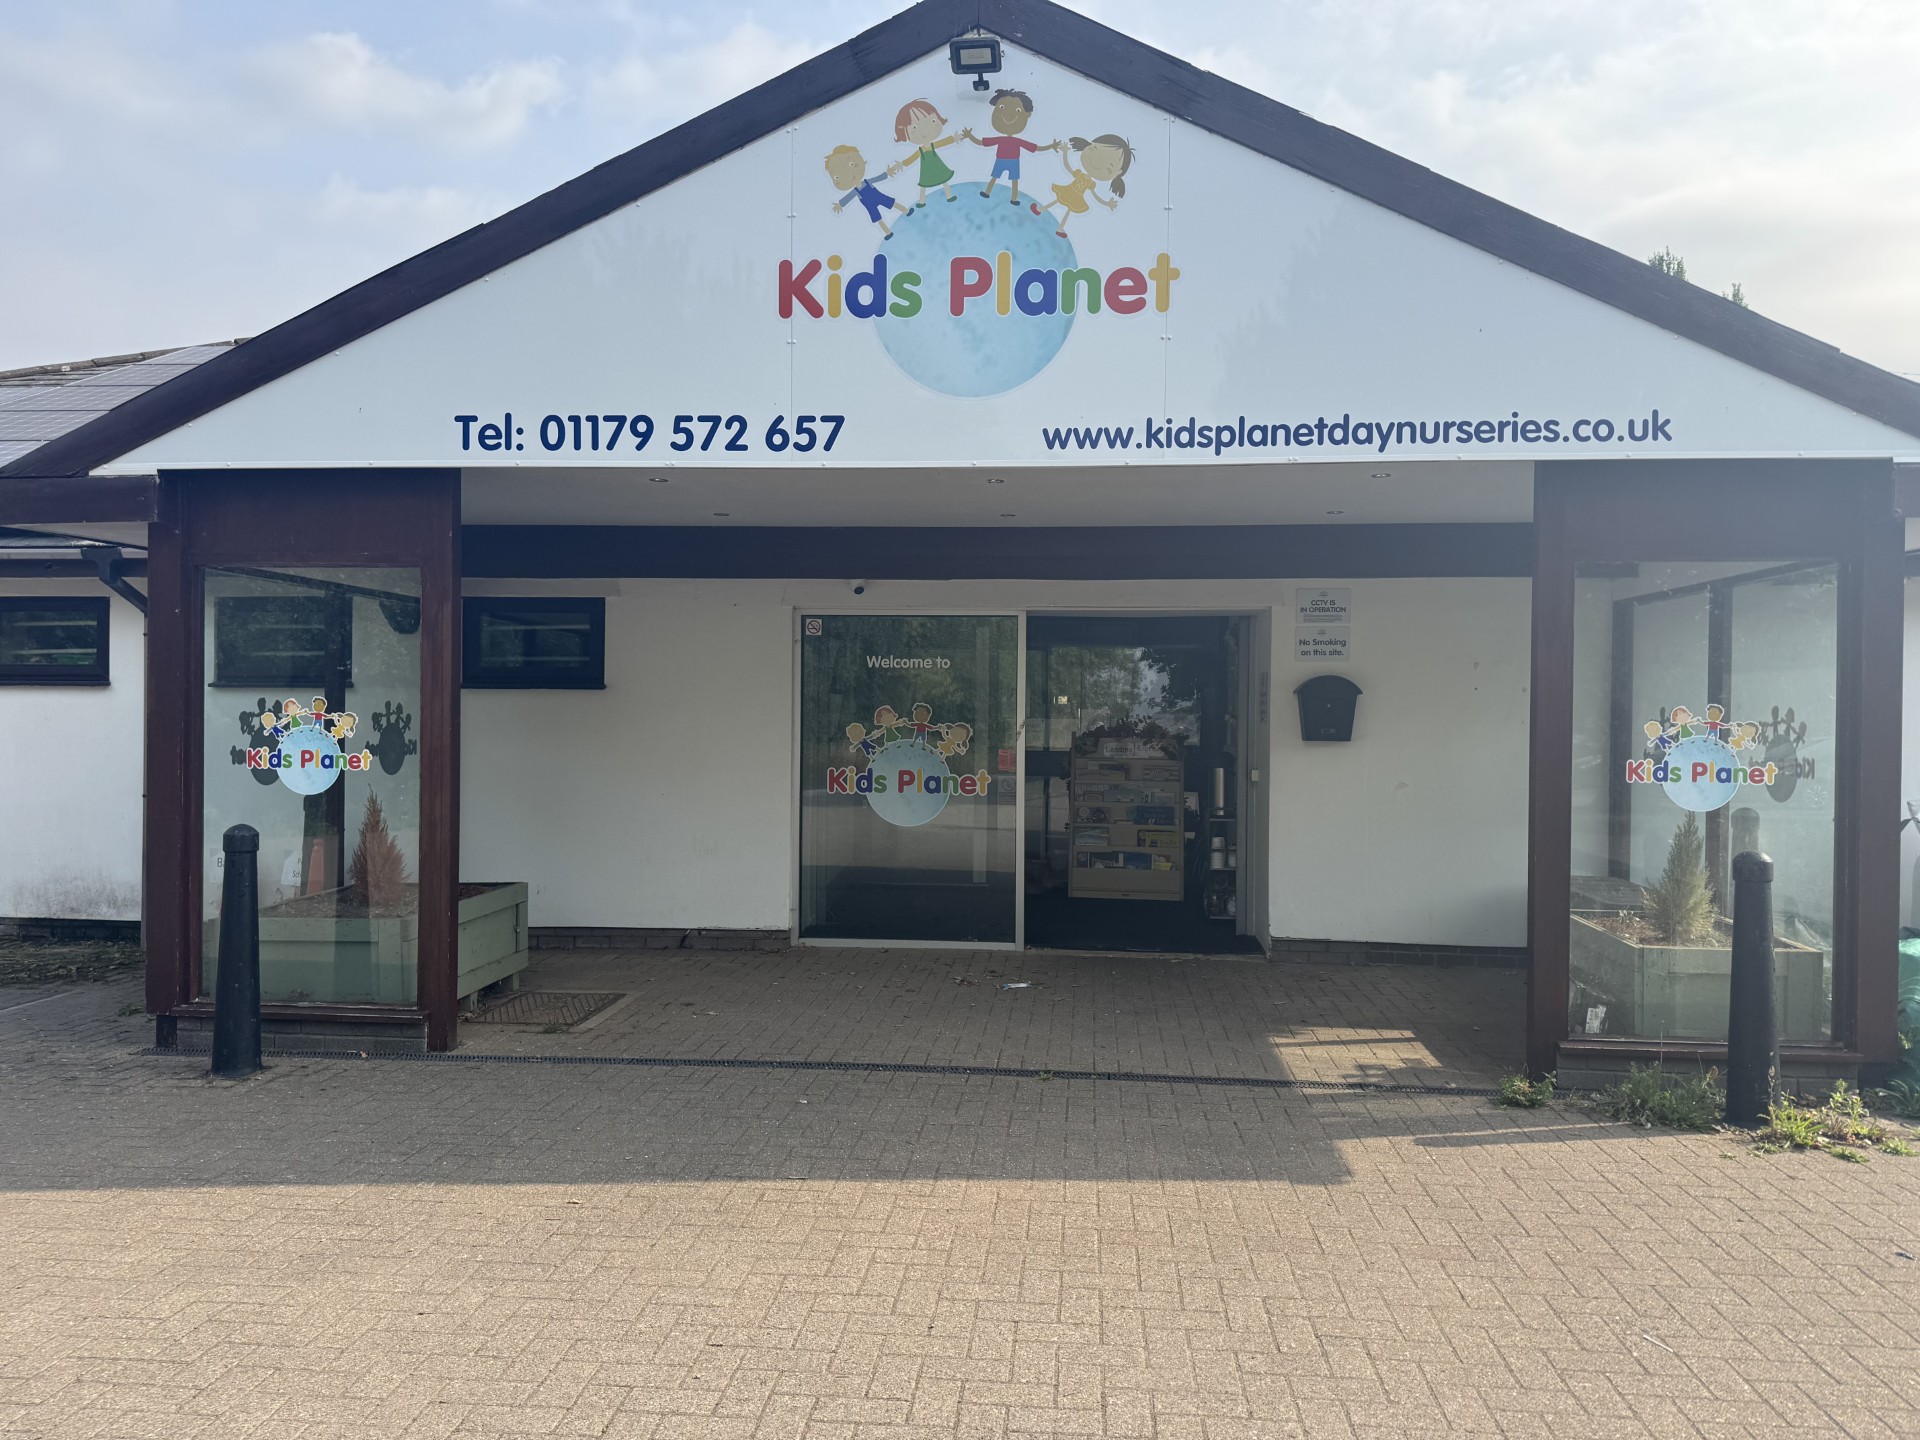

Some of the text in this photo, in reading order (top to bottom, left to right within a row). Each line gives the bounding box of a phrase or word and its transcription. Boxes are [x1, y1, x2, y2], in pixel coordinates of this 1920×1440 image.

[777, 250, 1181, 320] Kids Planet
[454, 412, 846, 452] Tel: 01179 572 657
[1042, 408, 1673, 457] www.kidsplanetdaynurseries.co.uk
[1299, 638, 1347, 648] No Smoking
[1313, 648, 1327, 656] this
[1328, 648, 1345, 656] site.
[866, 654, 951, 669] Welcome to
[247, 746, 292, 770] Kids
[300, 747, 372, 771] Planet
[827, 766, 991, 797] Kids Planet
[1626, 759, 1682, 783] Kids
[1691, 761, 1777, 785] Planet
